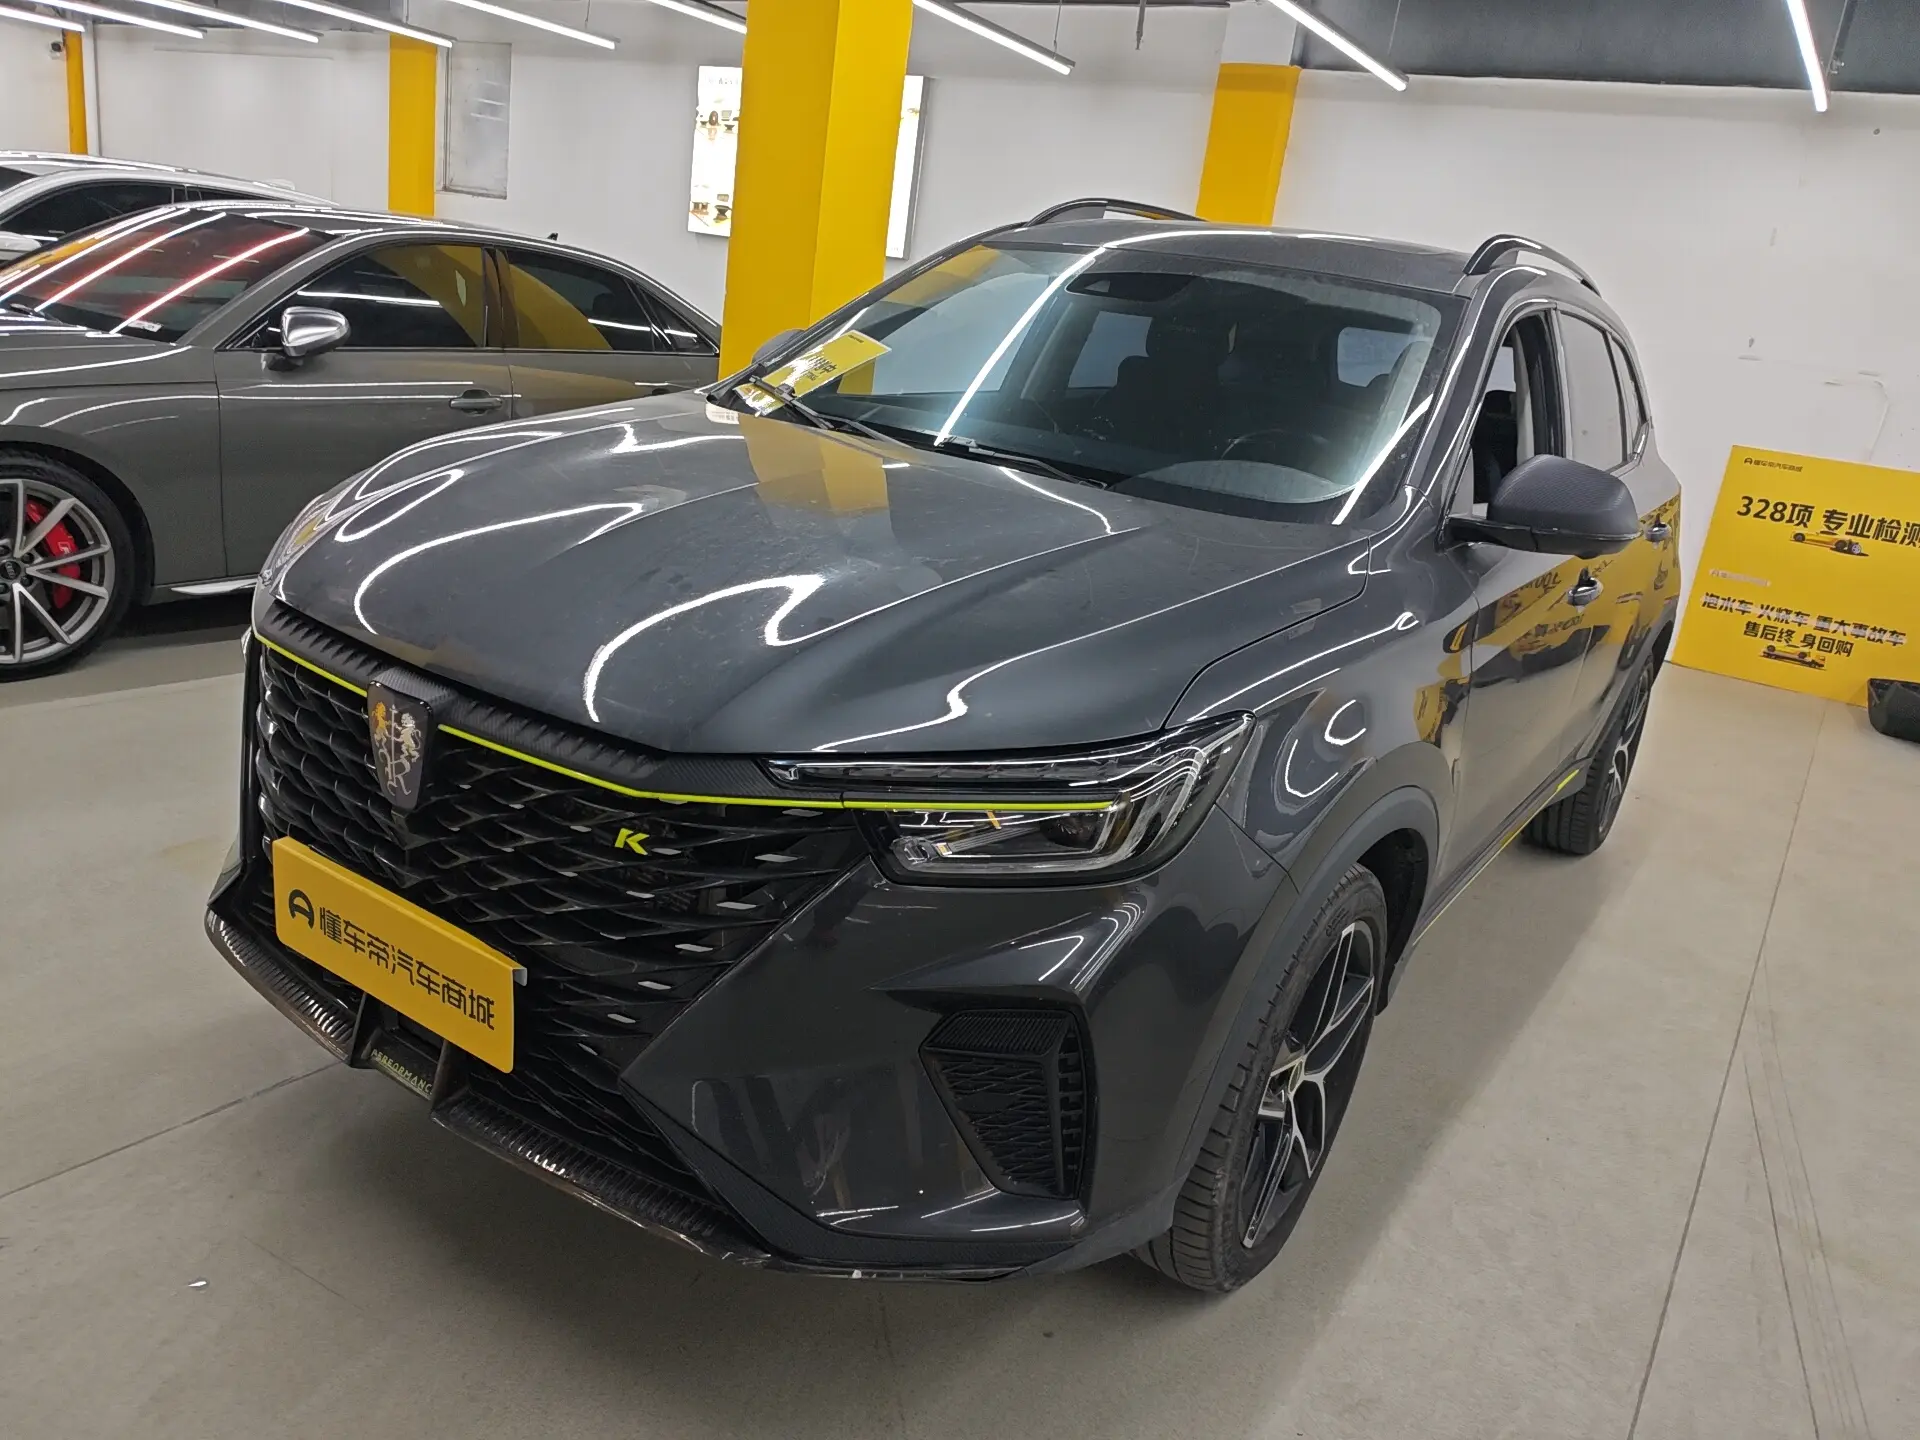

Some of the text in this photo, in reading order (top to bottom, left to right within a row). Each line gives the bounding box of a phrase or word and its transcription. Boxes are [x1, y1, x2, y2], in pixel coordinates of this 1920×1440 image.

[1736, 495, 1920, 549] 328项 专业检测
[1701, 592, 1907, 647] 泡水车 火烧车 重大事故车
[319, 906, 495, 1031] 懂车帝汽车商城
[370, 1048, 434, 1096] PERFORMANC
